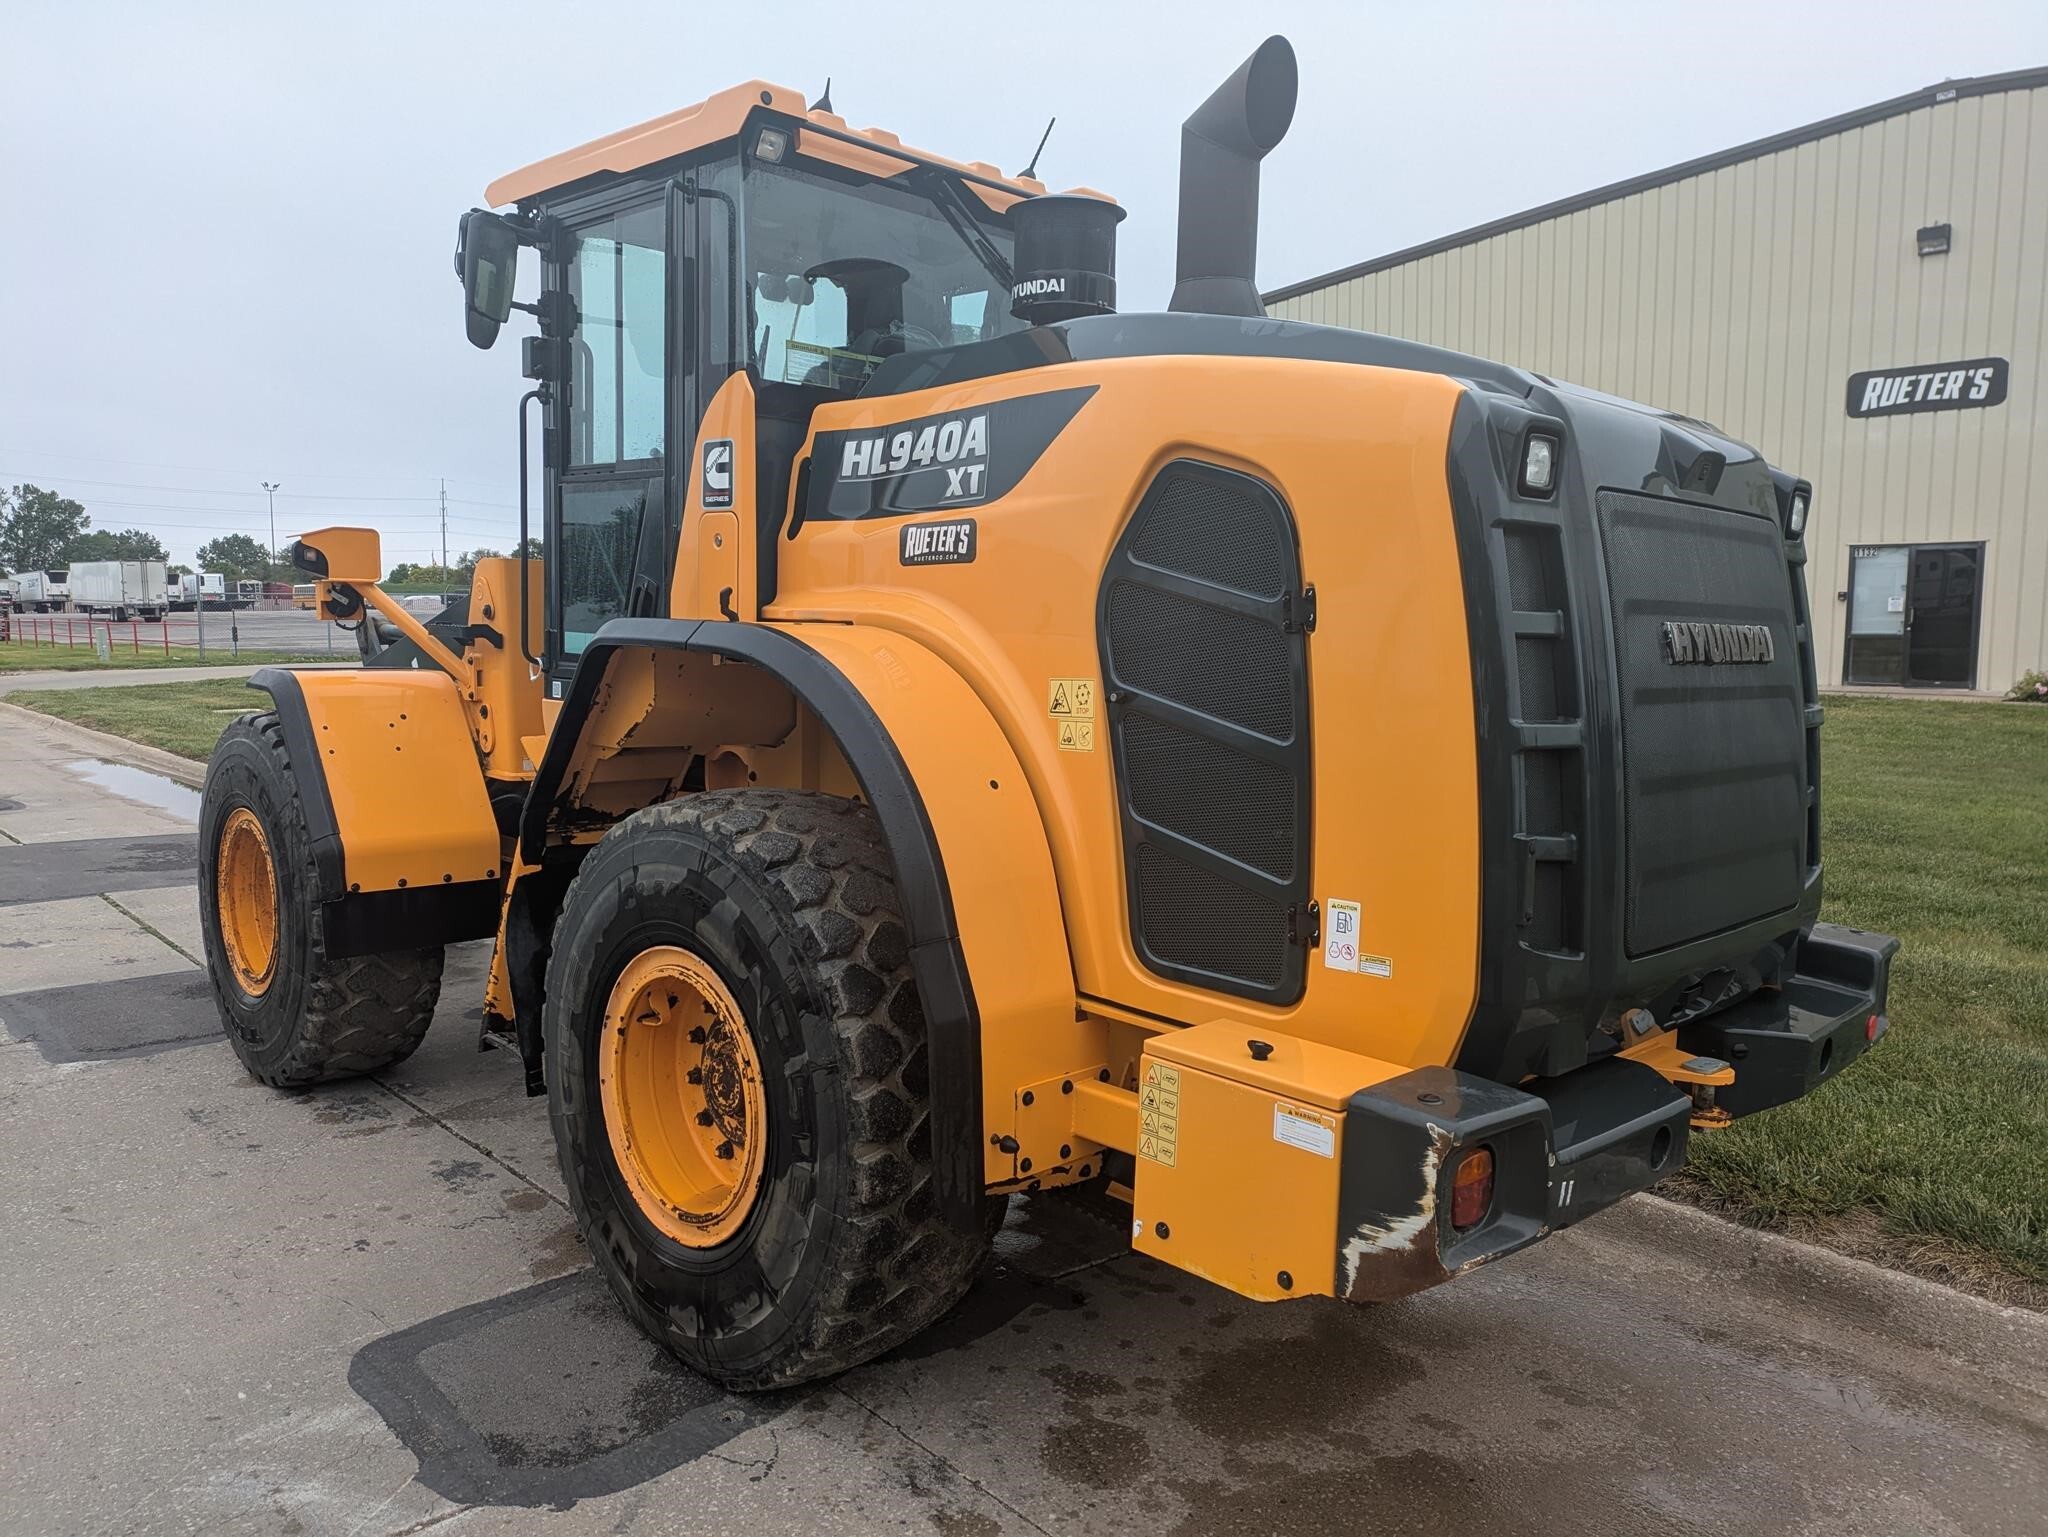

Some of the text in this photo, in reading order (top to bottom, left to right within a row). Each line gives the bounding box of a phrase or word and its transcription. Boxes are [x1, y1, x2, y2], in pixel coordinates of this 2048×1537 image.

[1860, 367, 1994, 412] RUETER'S
[841, 415, 989, 478] HL940A
[944, 464, 986, 498] XT
[905, 524, 970, 558] RUETER'S
[1665, 622, 1774, 664] HYUNDAI
[1337, 903, 1358, 911] CAUTION
[1294, 1110, 1322, 1124] WARNING
